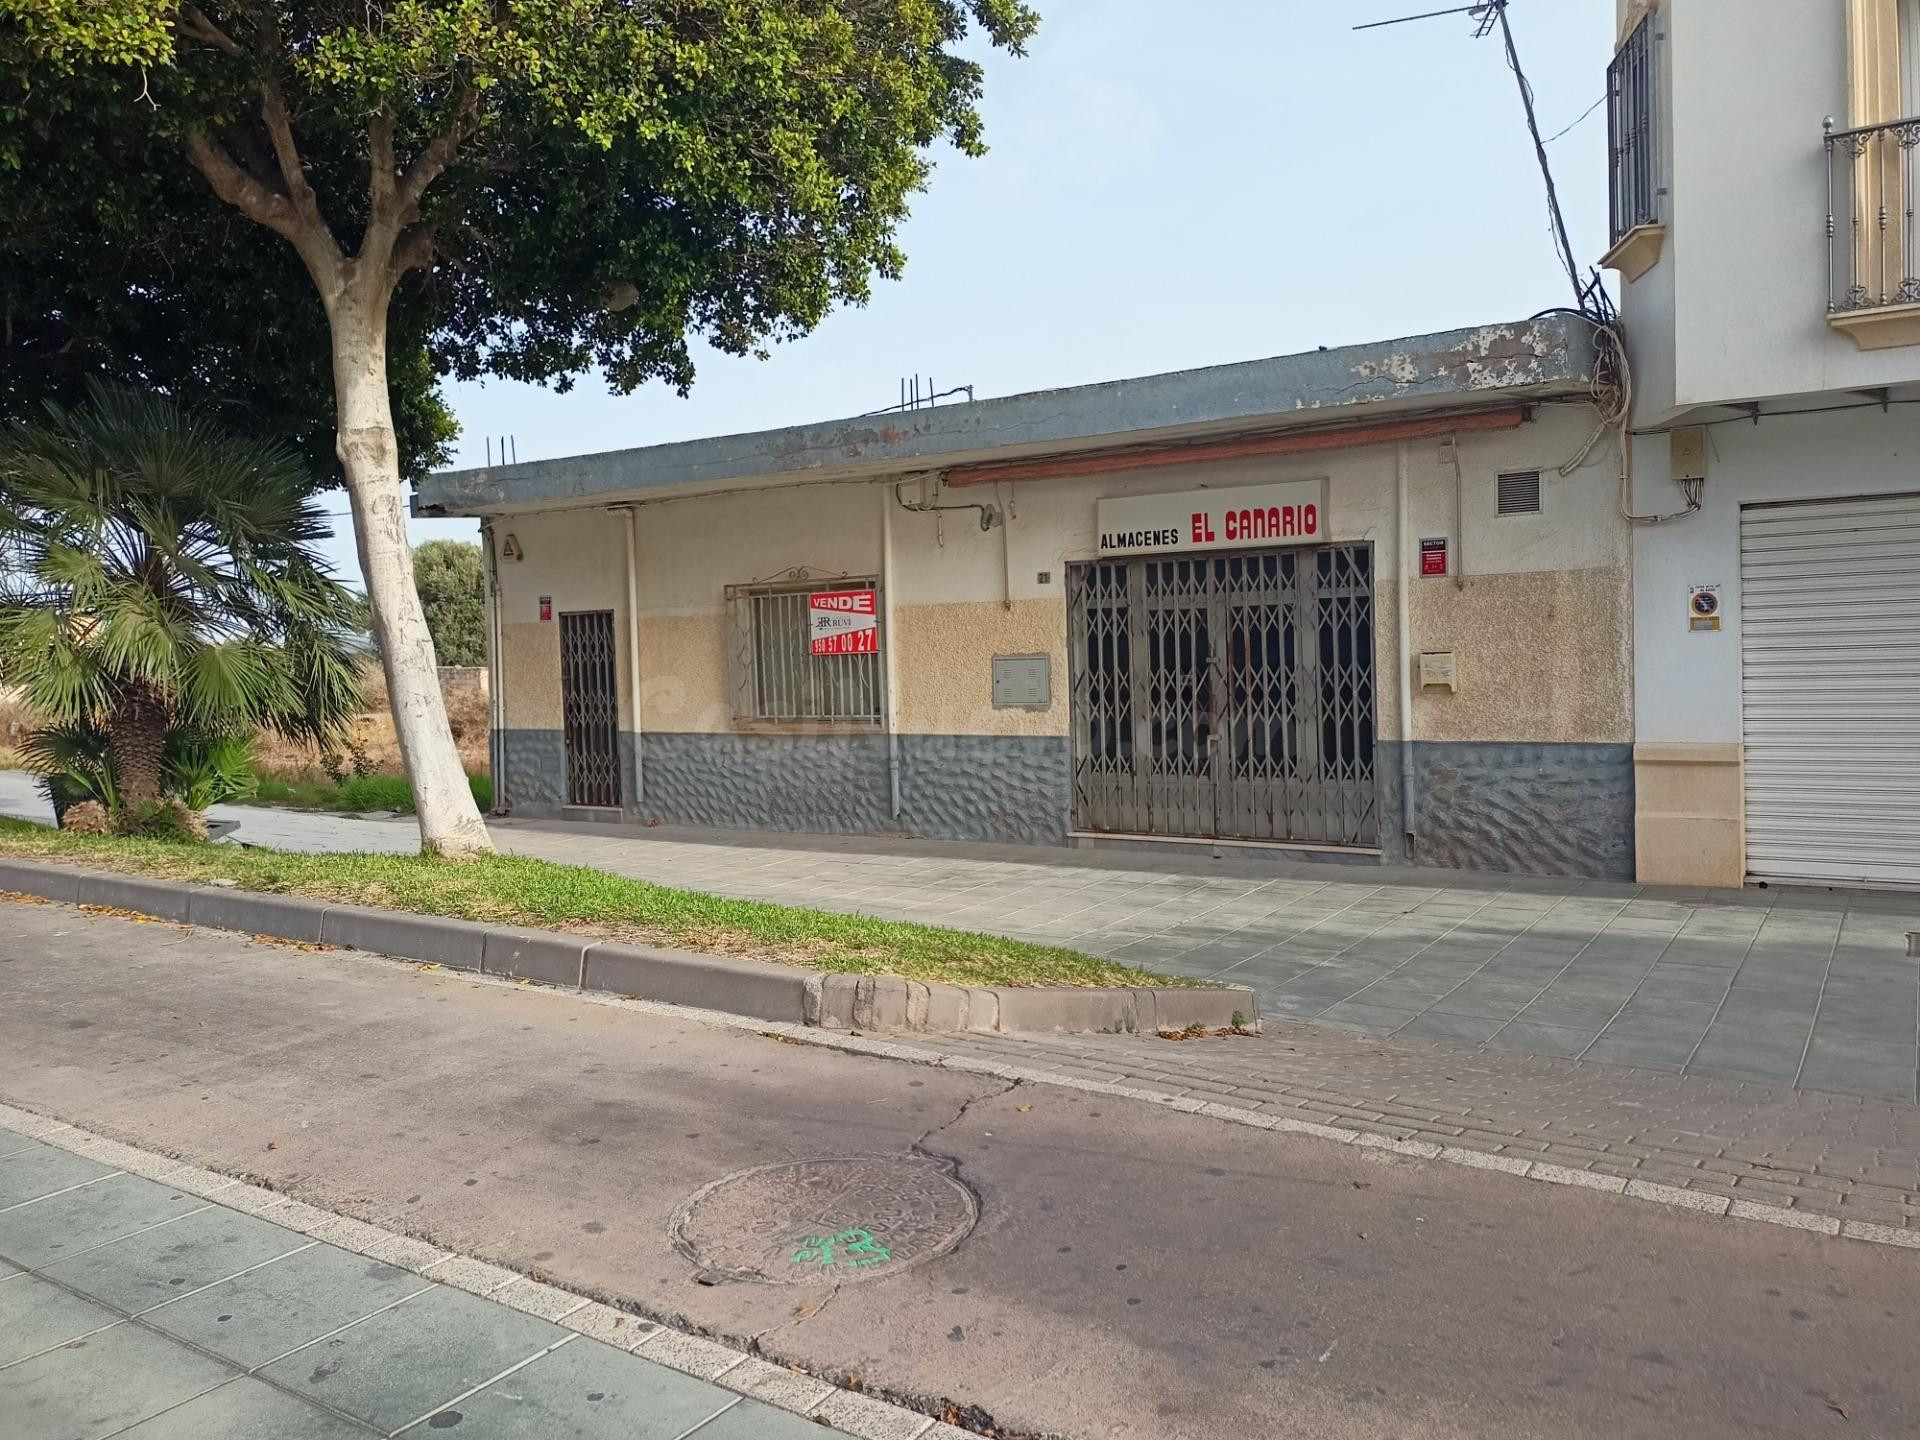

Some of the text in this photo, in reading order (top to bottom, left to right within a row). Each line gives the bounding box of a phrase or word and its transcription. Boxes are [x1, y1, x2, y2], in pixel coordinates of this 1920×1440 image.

[1101, 503, 1317, 549] ALMACENES EL CANARIO
[813, 595, 871, 611] VENDE
[832, 618, 852, 627] RUVI
[828, 637, 837, 651] 57
[841, 633, 853, 651] 00
[857, 629, 873, 651] 27
